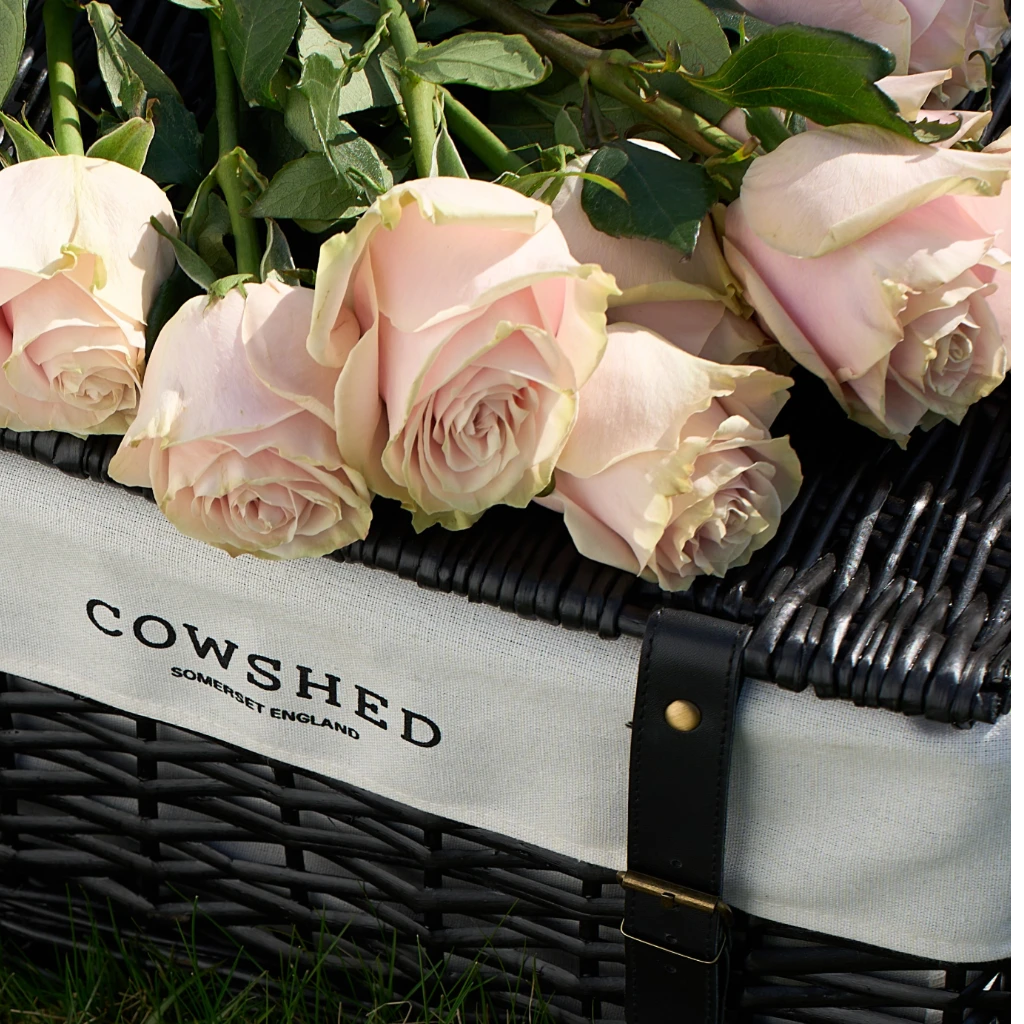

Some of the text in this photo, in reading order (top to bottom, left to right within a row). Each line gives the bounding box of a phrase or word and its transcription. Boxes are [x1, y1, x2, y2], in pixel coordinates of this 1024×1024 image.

[86, 598, 442, 748] COWSHED
[171, 666, 360, 740] SOMERSET ENGLAND
